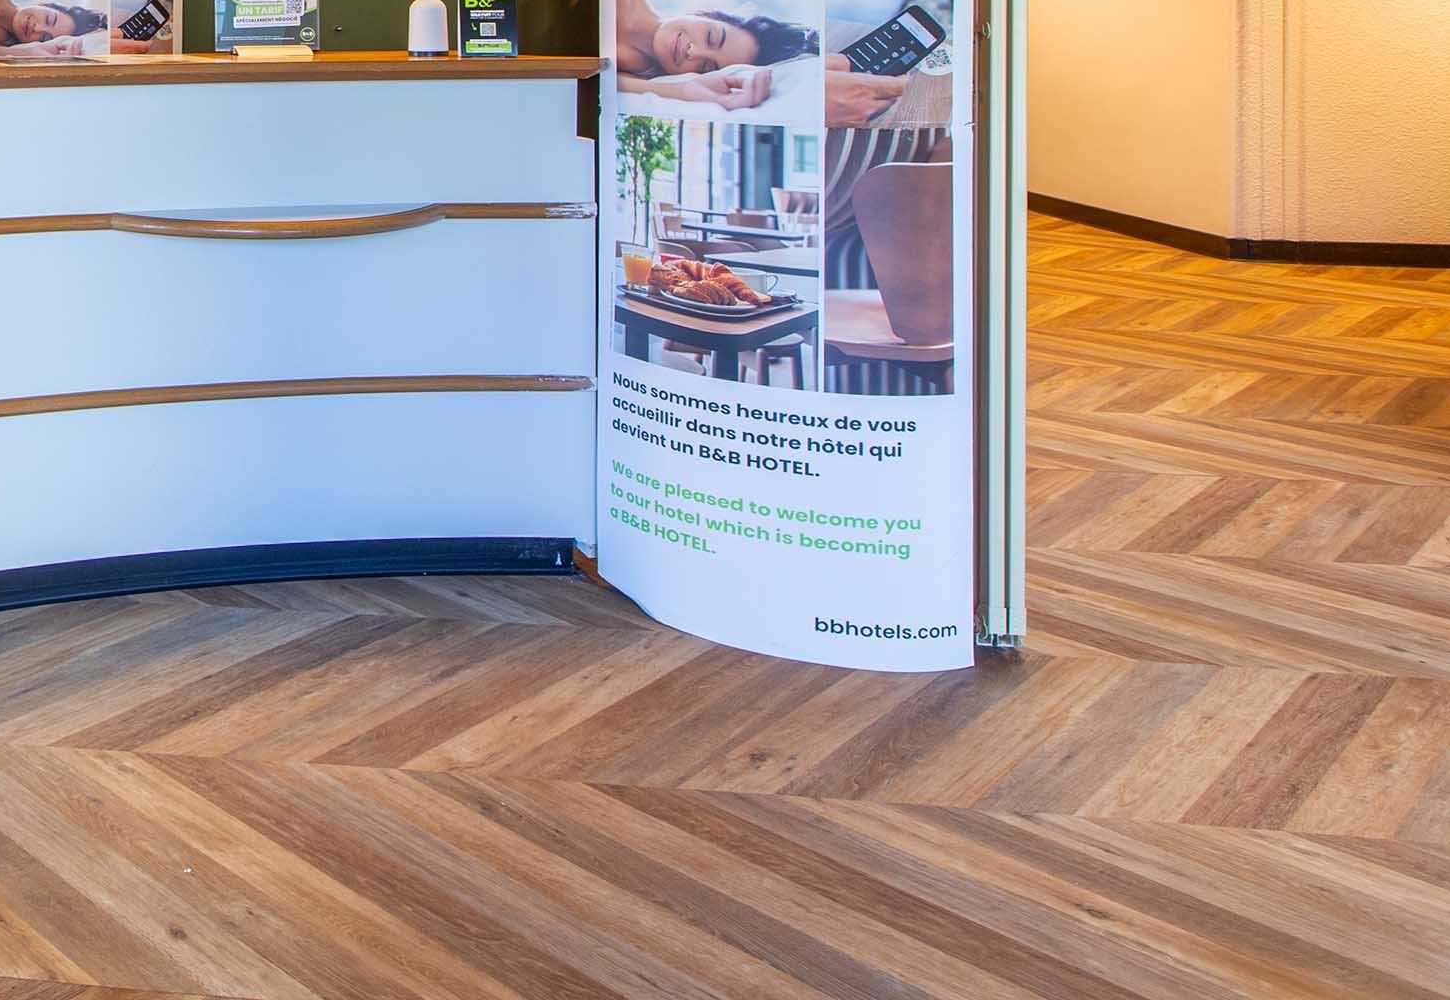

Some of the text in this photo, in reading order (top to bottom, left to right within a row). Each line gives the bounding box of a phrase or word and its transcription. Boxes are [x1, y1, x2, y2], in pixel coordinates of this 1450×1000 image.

[254, 6, 284, 15] TARIF
[612, 396, 902, 461] accueillir dans notre hôtel qui
[613, 371, 916, 432] Nous sommes heureux de vous
[612, 418, 820, 477] devient un B&B HOTEL.
[610, 482, 911, 560] to our hotel which is becoming
[612, 459, 921, 535] We are pleased to welcome you
[610, 506, 716, 554] a B&B HOTEL.
[814, 617, 958, 641] bbhotels.com
